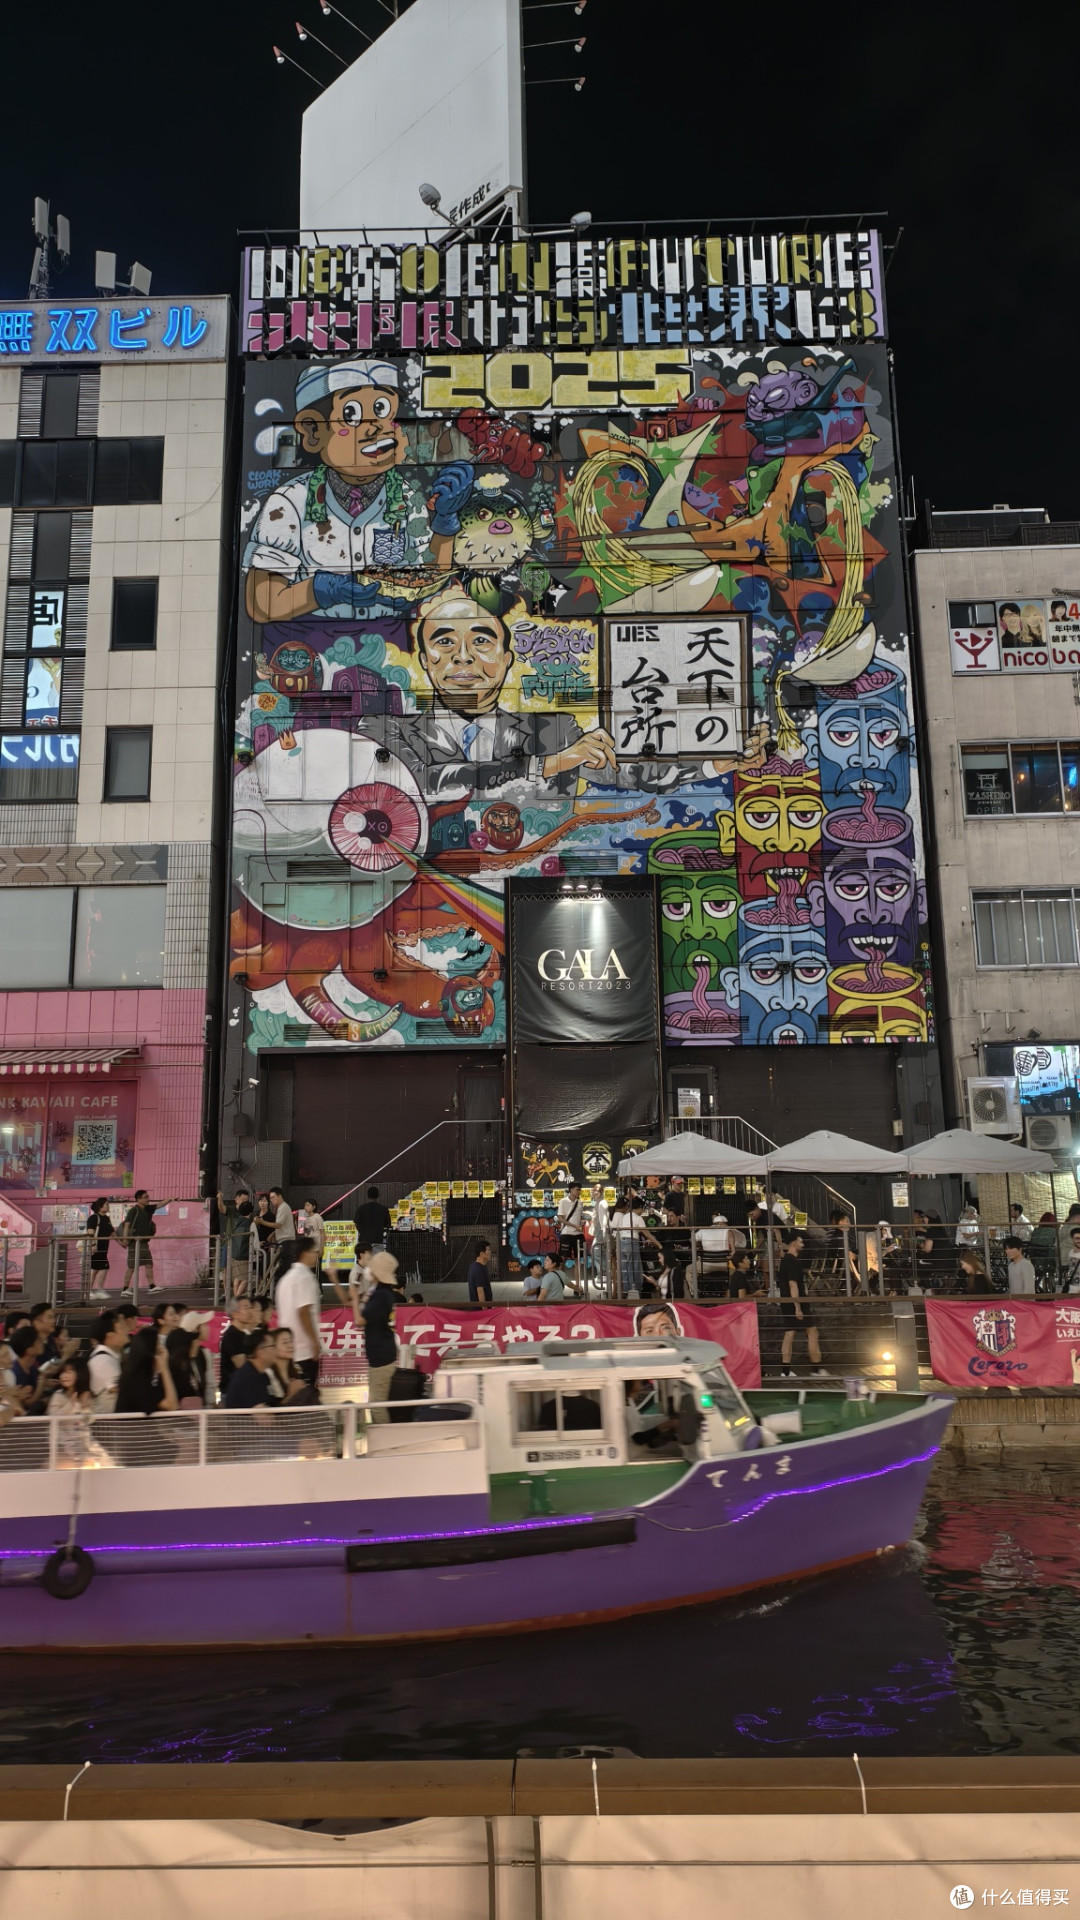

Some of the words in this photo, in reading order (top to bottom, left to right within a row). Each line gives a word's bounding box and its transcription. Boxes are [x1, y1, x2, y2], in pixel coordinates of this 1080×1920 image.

[0, 307, 208, 354] 無双ビル
[422, 350, 692, 409] 2025
[247, 478, 280, 490] WORK
[514, 625, 595, 654] DESIGN
[529, 651, 584, 677] FOR
[1004, 650, 1049, 667] nico
[521, 673, 594, 703] FUTURE
[686, 627, 735, 745] 天下の
[621, 656, 676, 752] 台所
[537, 948, 631, 981] GALA
[365, 1009, 400, 1038] KITCHEN
[80, 1096, 119, 1108] CAFE
[968, 1356, 1029, 1377] Cerezo
